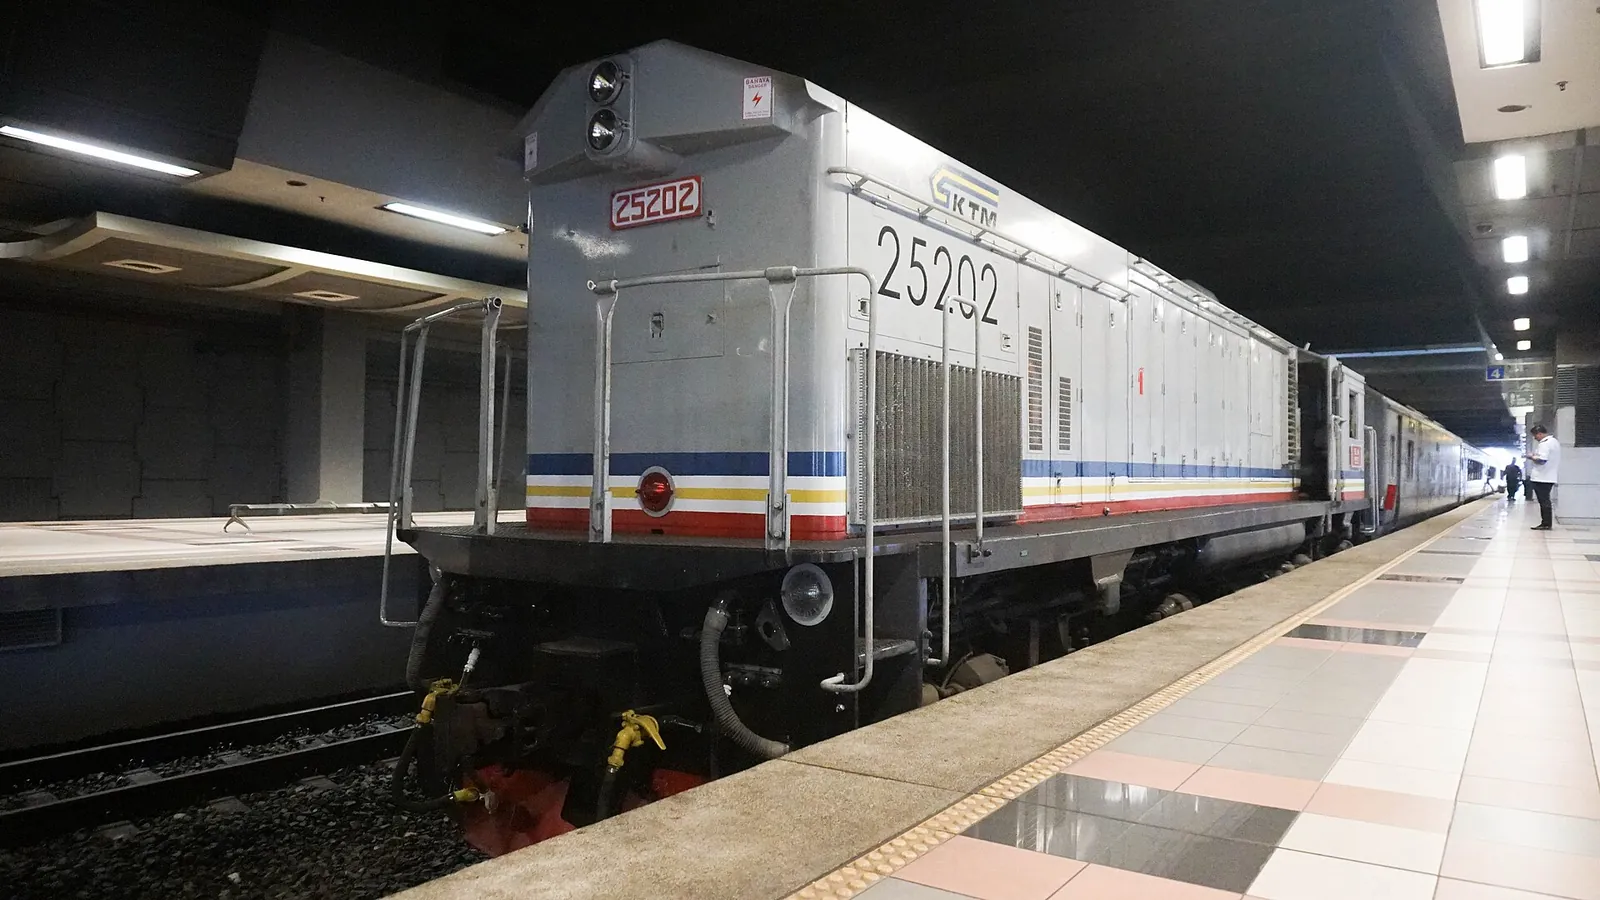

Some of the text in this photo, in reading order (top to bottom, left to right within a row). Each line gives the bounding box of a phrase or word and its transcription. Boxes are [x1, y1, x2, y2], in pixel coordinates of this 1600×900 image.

[616, 181, 694, 223] 25202
[952, 193, 998, 227] KTM
[877, 225, 998, 326] 25202
[1490, 368, 1501, 379] 4
